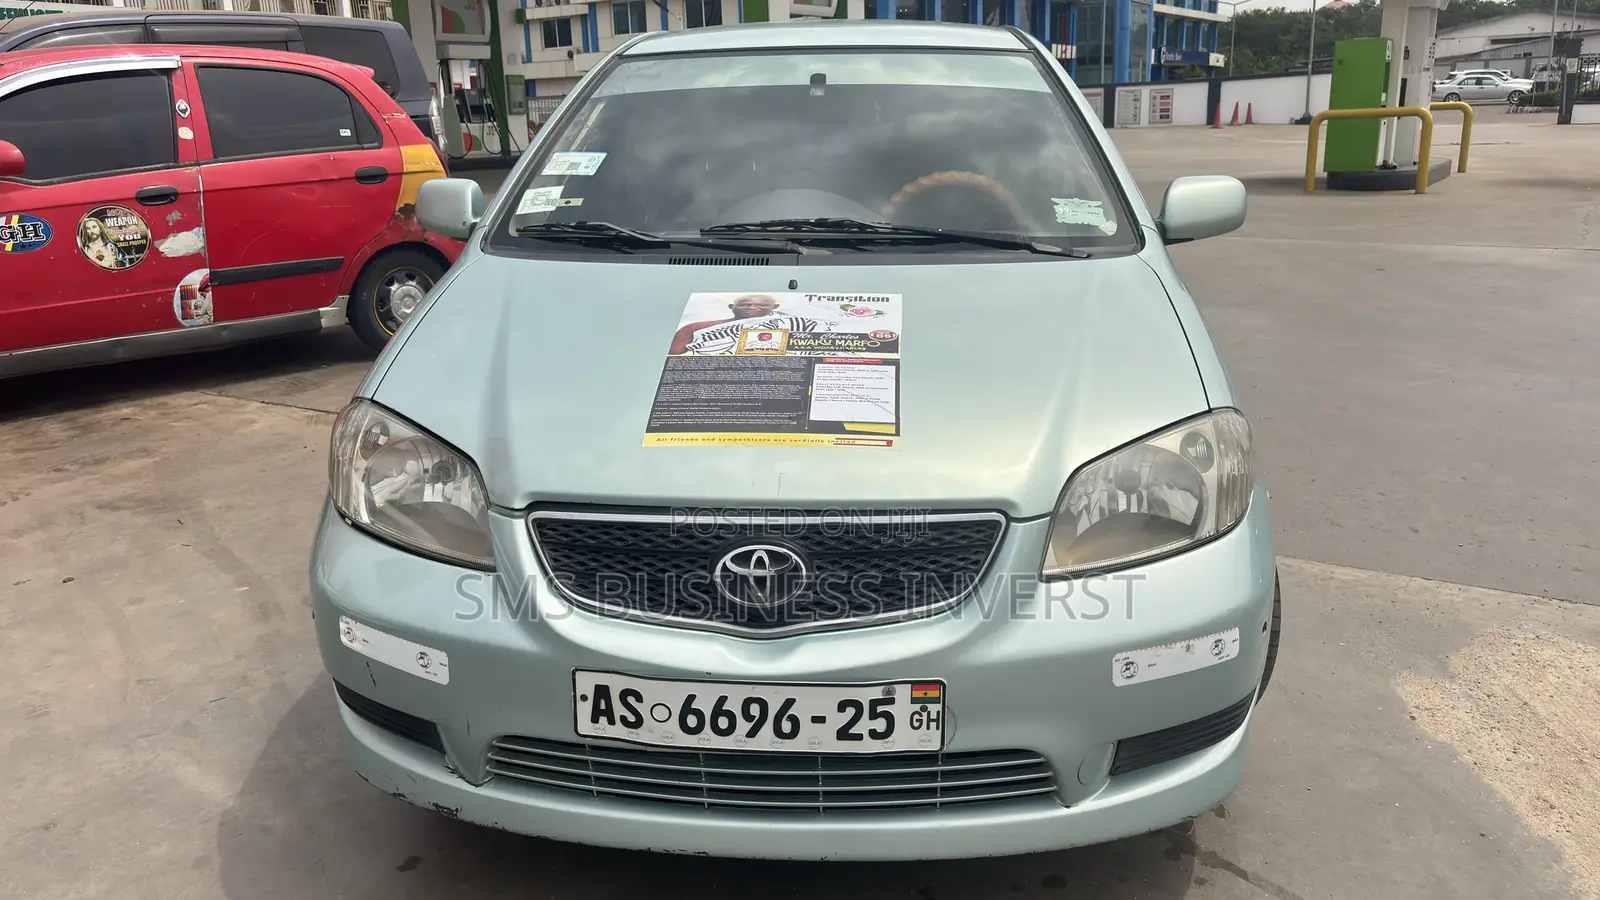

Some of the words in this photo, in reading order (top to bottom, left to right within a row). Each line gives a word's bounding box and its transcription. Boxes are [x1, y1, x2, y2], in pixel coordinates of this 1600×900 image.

[105, 216, 138, 227] WEAPON
[805, 294, 890, 303] Transition
[820, 333, 859, 341] Charles
[590, 684, 644, 729] AS
[909, 710, 940, 731] GH
